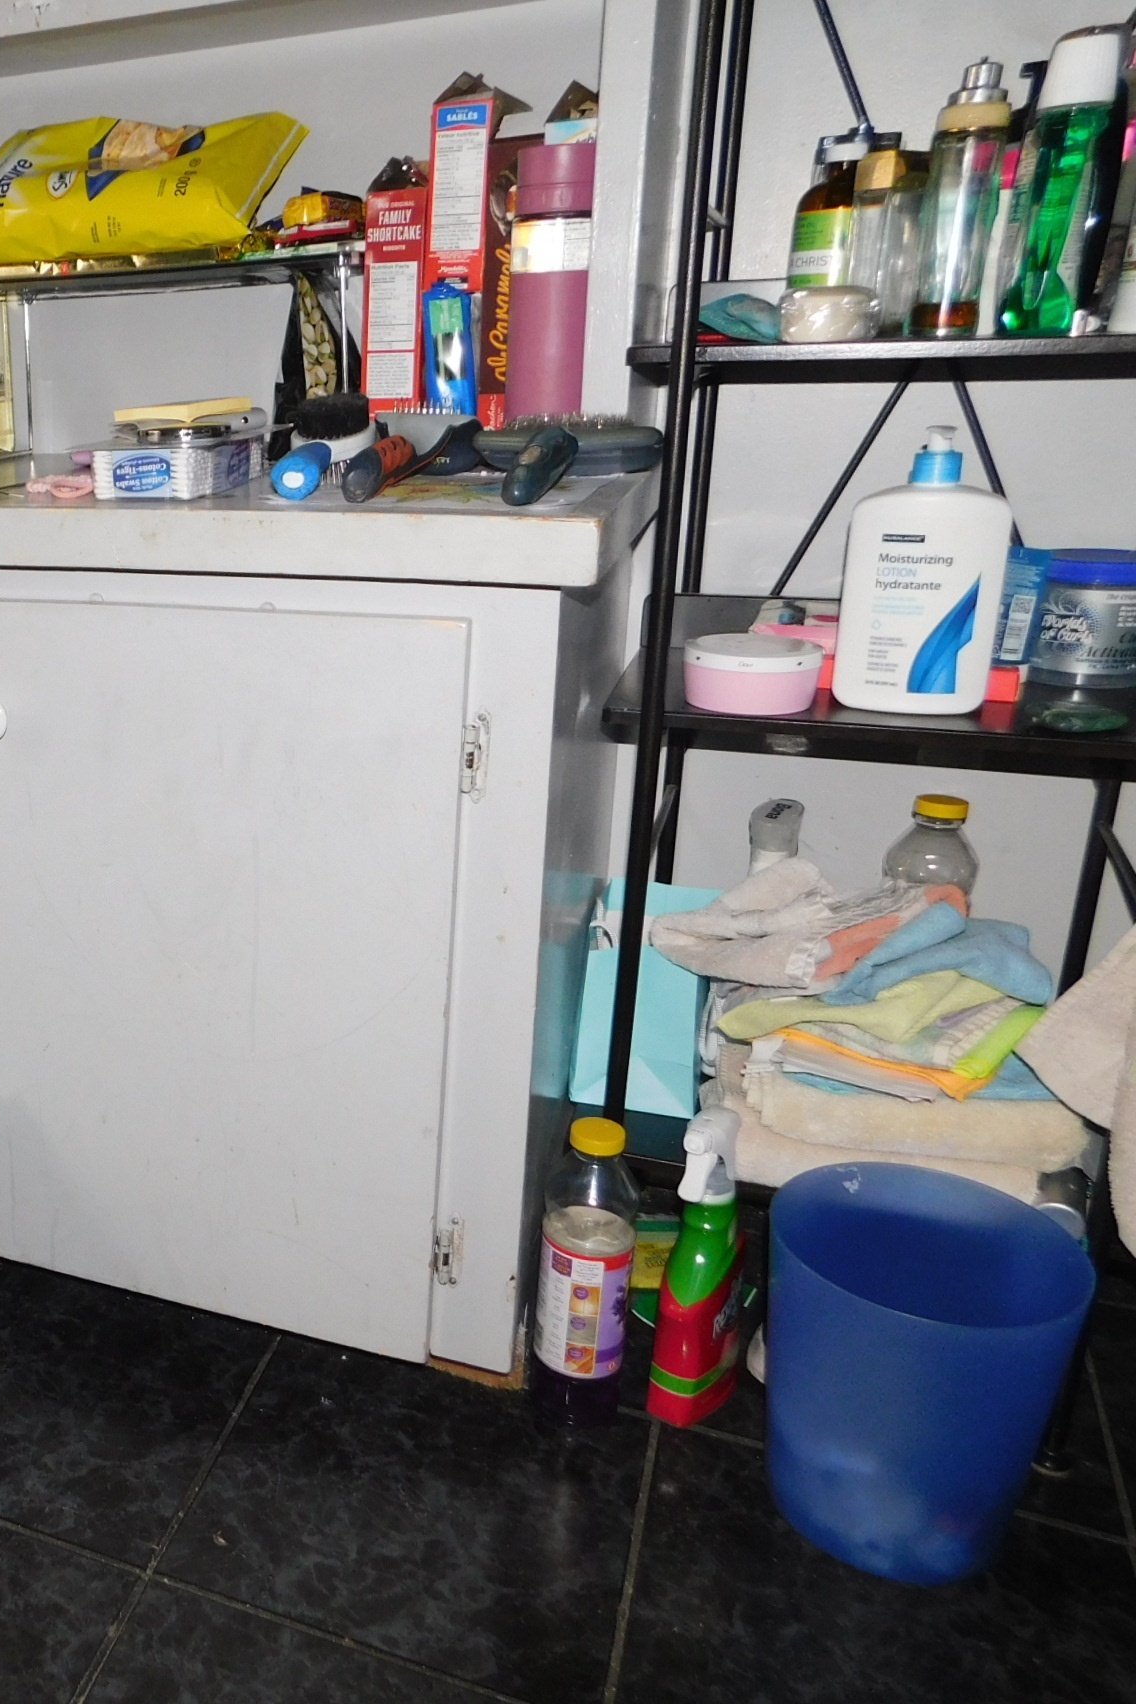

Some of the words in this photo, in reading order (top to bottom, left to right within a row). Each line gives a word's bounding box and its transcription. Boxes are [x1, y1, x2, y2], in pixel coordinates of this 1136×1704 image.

[446, 111, 478, 122] SABLÉS
[378, 208, 413, 226] FAMILY
[367, 224, 422, 243] SHORTCAKE
[115, 479, 141, 489] Swabs
[141, 475, 169, 485] Cotton
[878, 553, 954, 568] Moisturizing
[876, 566, 917, 578] LOTION
[875, 578, 942, 592] hydratante
